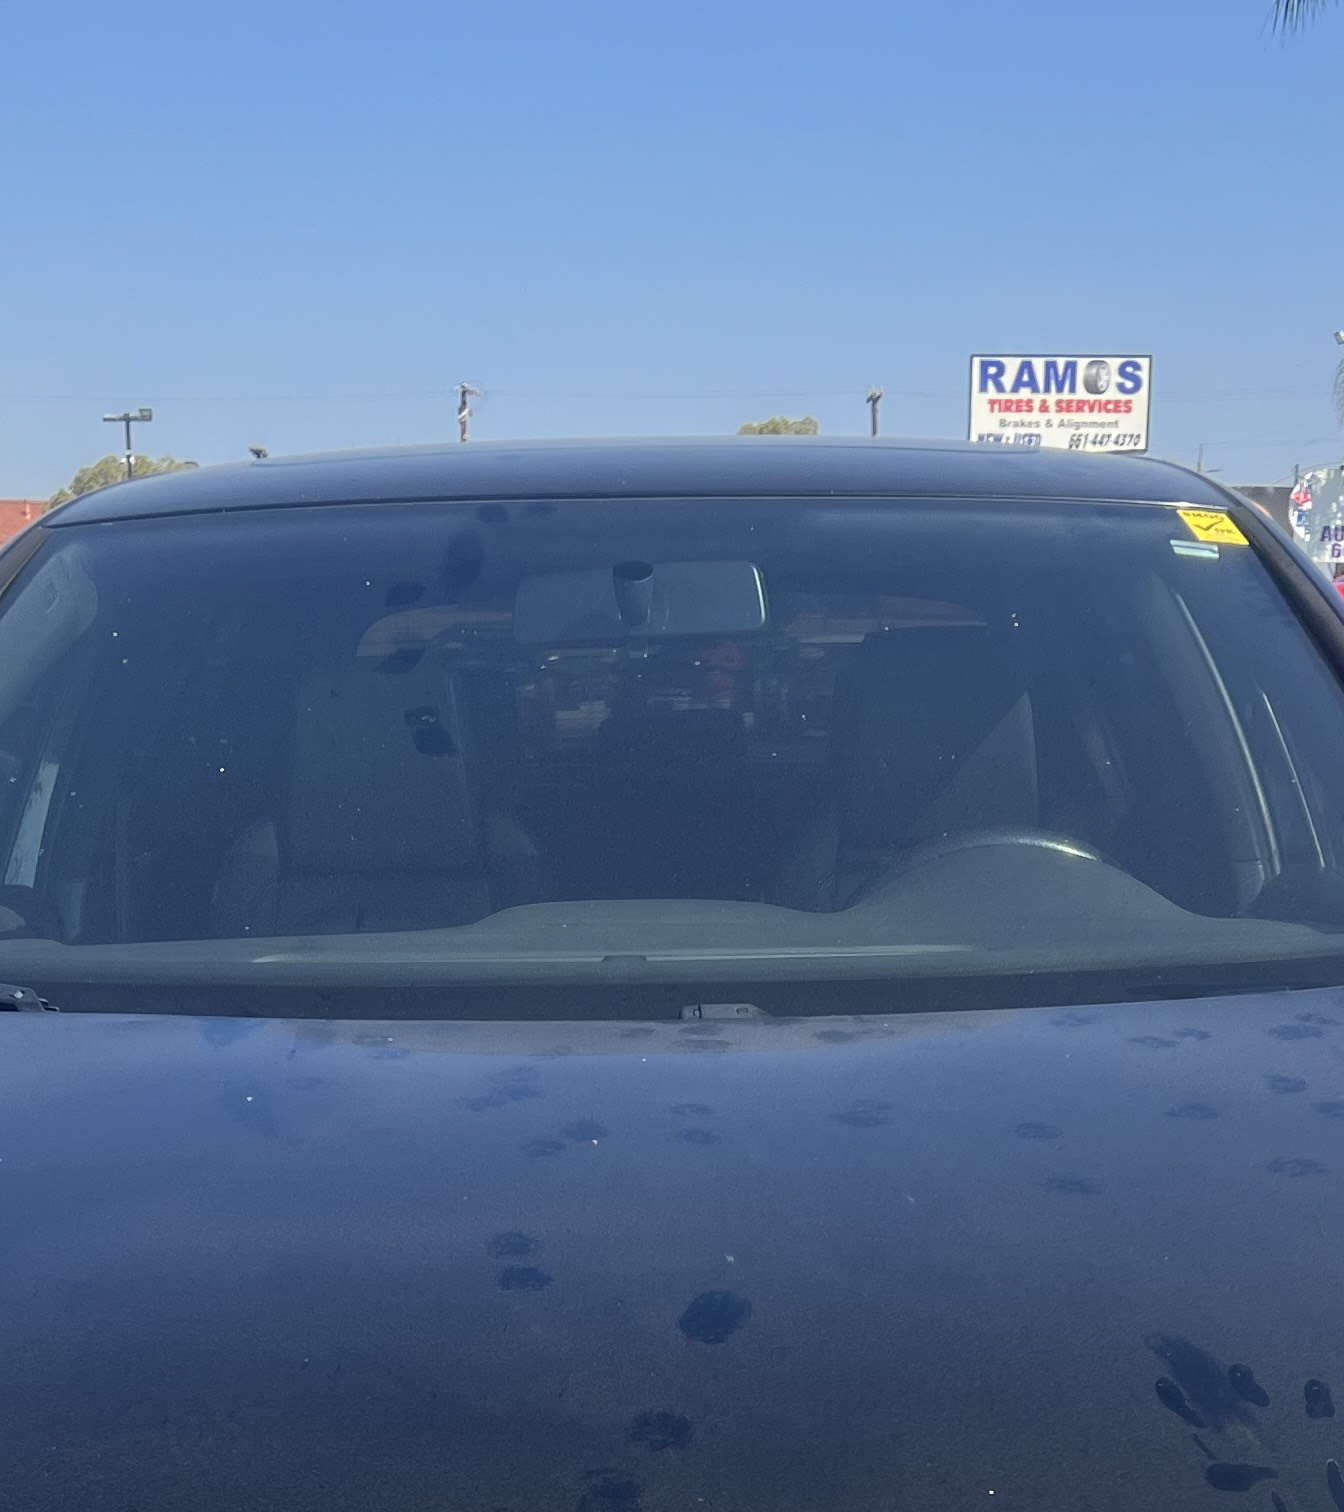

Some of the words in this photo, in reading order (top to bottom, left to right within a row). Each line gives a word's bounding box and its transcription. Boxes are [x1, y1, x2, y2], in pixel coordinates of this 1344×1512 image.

[978, 359, 1144, 395] RAMOS
[988, 398, 1034, 414] TIRES
[1038, 398, 1050, 413] &
[1054, 399, 1133, 414] SERVICES
[999, 418, 1041, 429] Brakes
[1044, 419, 1053, 428] &
[1057, 419, 1119, 431] Alignment
